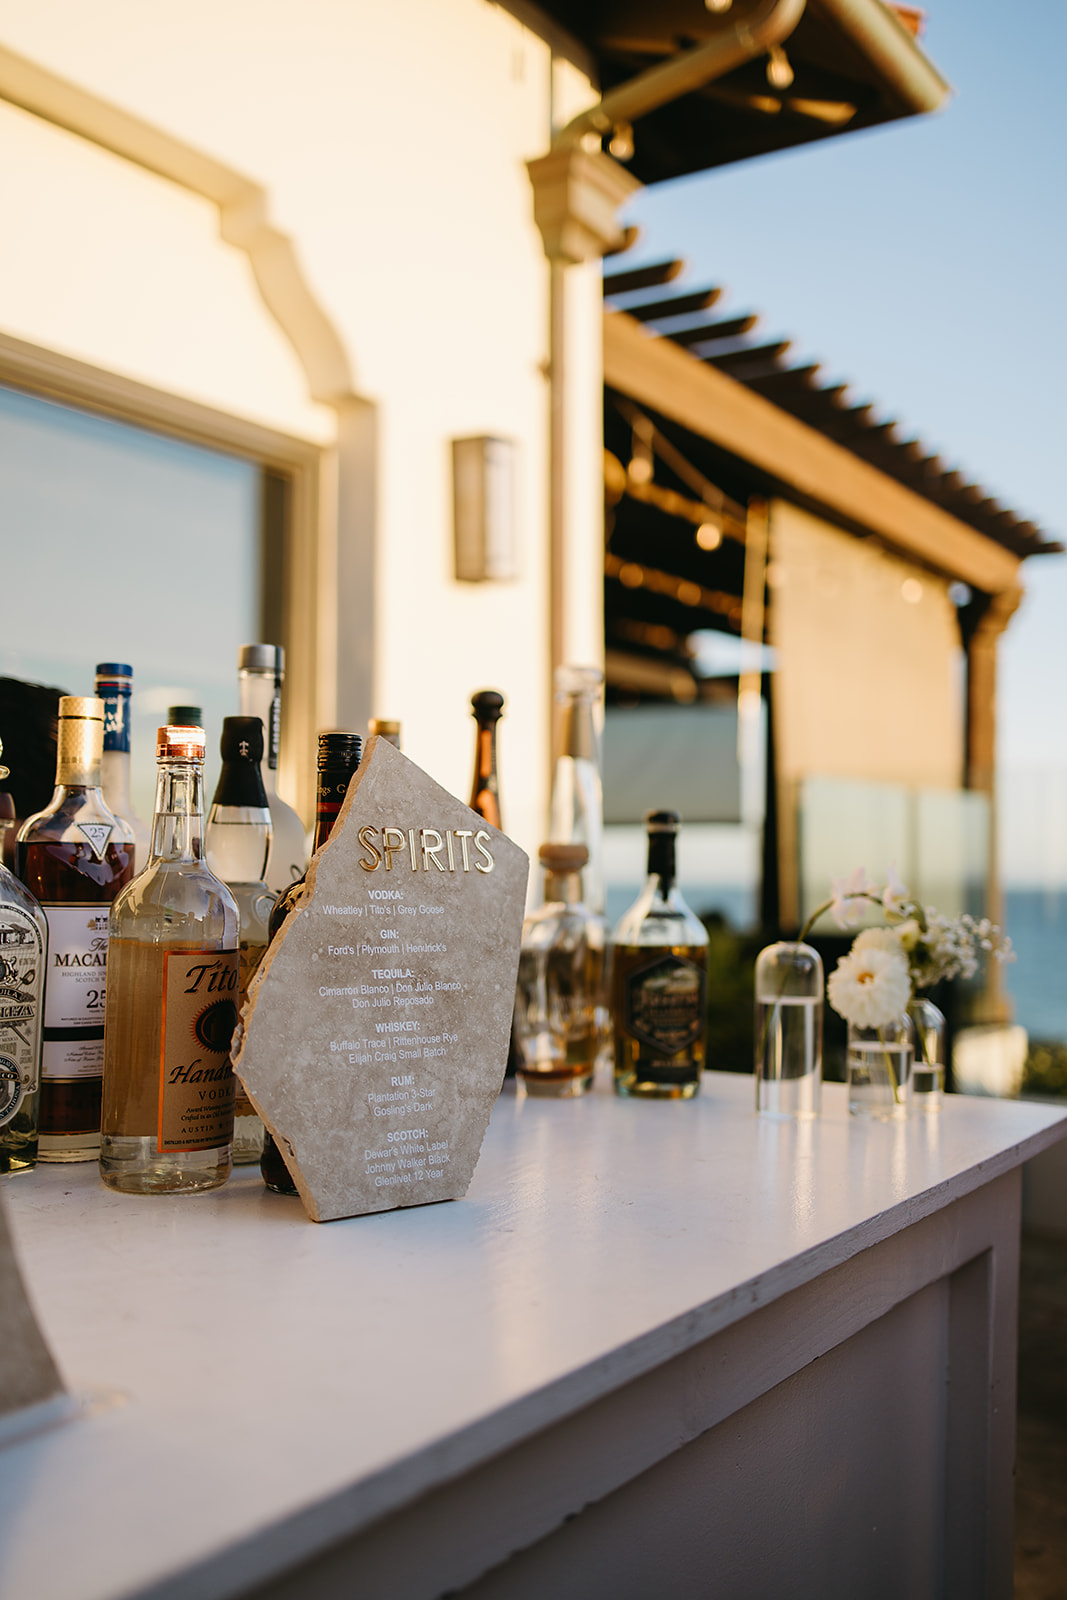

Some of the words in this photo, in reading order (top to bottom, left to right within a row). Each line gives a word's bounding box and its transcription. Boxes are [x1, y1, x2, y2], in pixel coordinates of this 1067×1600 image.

[89, 827, 106, 839] 25
[358, 825, 497, 873] SPIRITS
[368, 890, 404, 900] VODKA:
[322, 905, 363, 917] Wheatley
[369, 905, 391, 914] Tito's
[397, 905, 417, 916] Grey
[419, 904, 445, 914] Goose
[380, 929, 399, 939] GIN:
[328, 945, 355, 956] Ford's
[361, 944, 400, 956] Plymouth
[406, 943, 447, 953] Hendrick's
[372, 969, 414, 979] TEQUILA:
[319, 986, 358, 997] Cimarron
[360, 984, 389, 995] Blanco
[395, 982, 413, 993] Don
[414, 981, 433, 992] Julio
[434, 980, 462, 991] Blanco
[86, 989, 106, 1009] 25
[352, 999, 370, 1009] Don
[372, 997, 391, 1008] Julio
[393, 995, 434, 1008] Reposado
[375, 1021, 421, 1033] WHISKEY:
[330, 1039, 361, 1051] Buffalo
[362, 1037, 386, 1049] Trace
[393, 1034, 441, 1047] Rittenhouse
[442, 1032, 458, 1045] Rye
[349, 1052, 373, 1065] Elijah
[374, 1050, 397, 1063] Craig
[399, 1048, 422, 1060] Small
[423, 1046, 447, 1058] Batch
[391, 1075, 415, 1087] RUM:
[368, 1090, 409, 1103] Plantation
[411, 1087, 436, 1100] 3-Star
[373, 1103, 412, 1117] Gosling's
[413, 1101, 433, 1113] Dark
[386, 1129, 429, 1143] SCOTCH:
[364, 1147, 399, 1161] Dewar's
[399, 1142, 425, 1156] White
[425, 1140, 449, 1153] Label
[364, 1161, 395, 1175] Johnny
[397, 1157, 426, 1170] Walker
[427, 1153, 451, 1166] Black
[374, 1172, 412, 1187] Glenlivet
[413, 1170, 424, 1181] 12
[425, 1168, 444, 1180] Year
